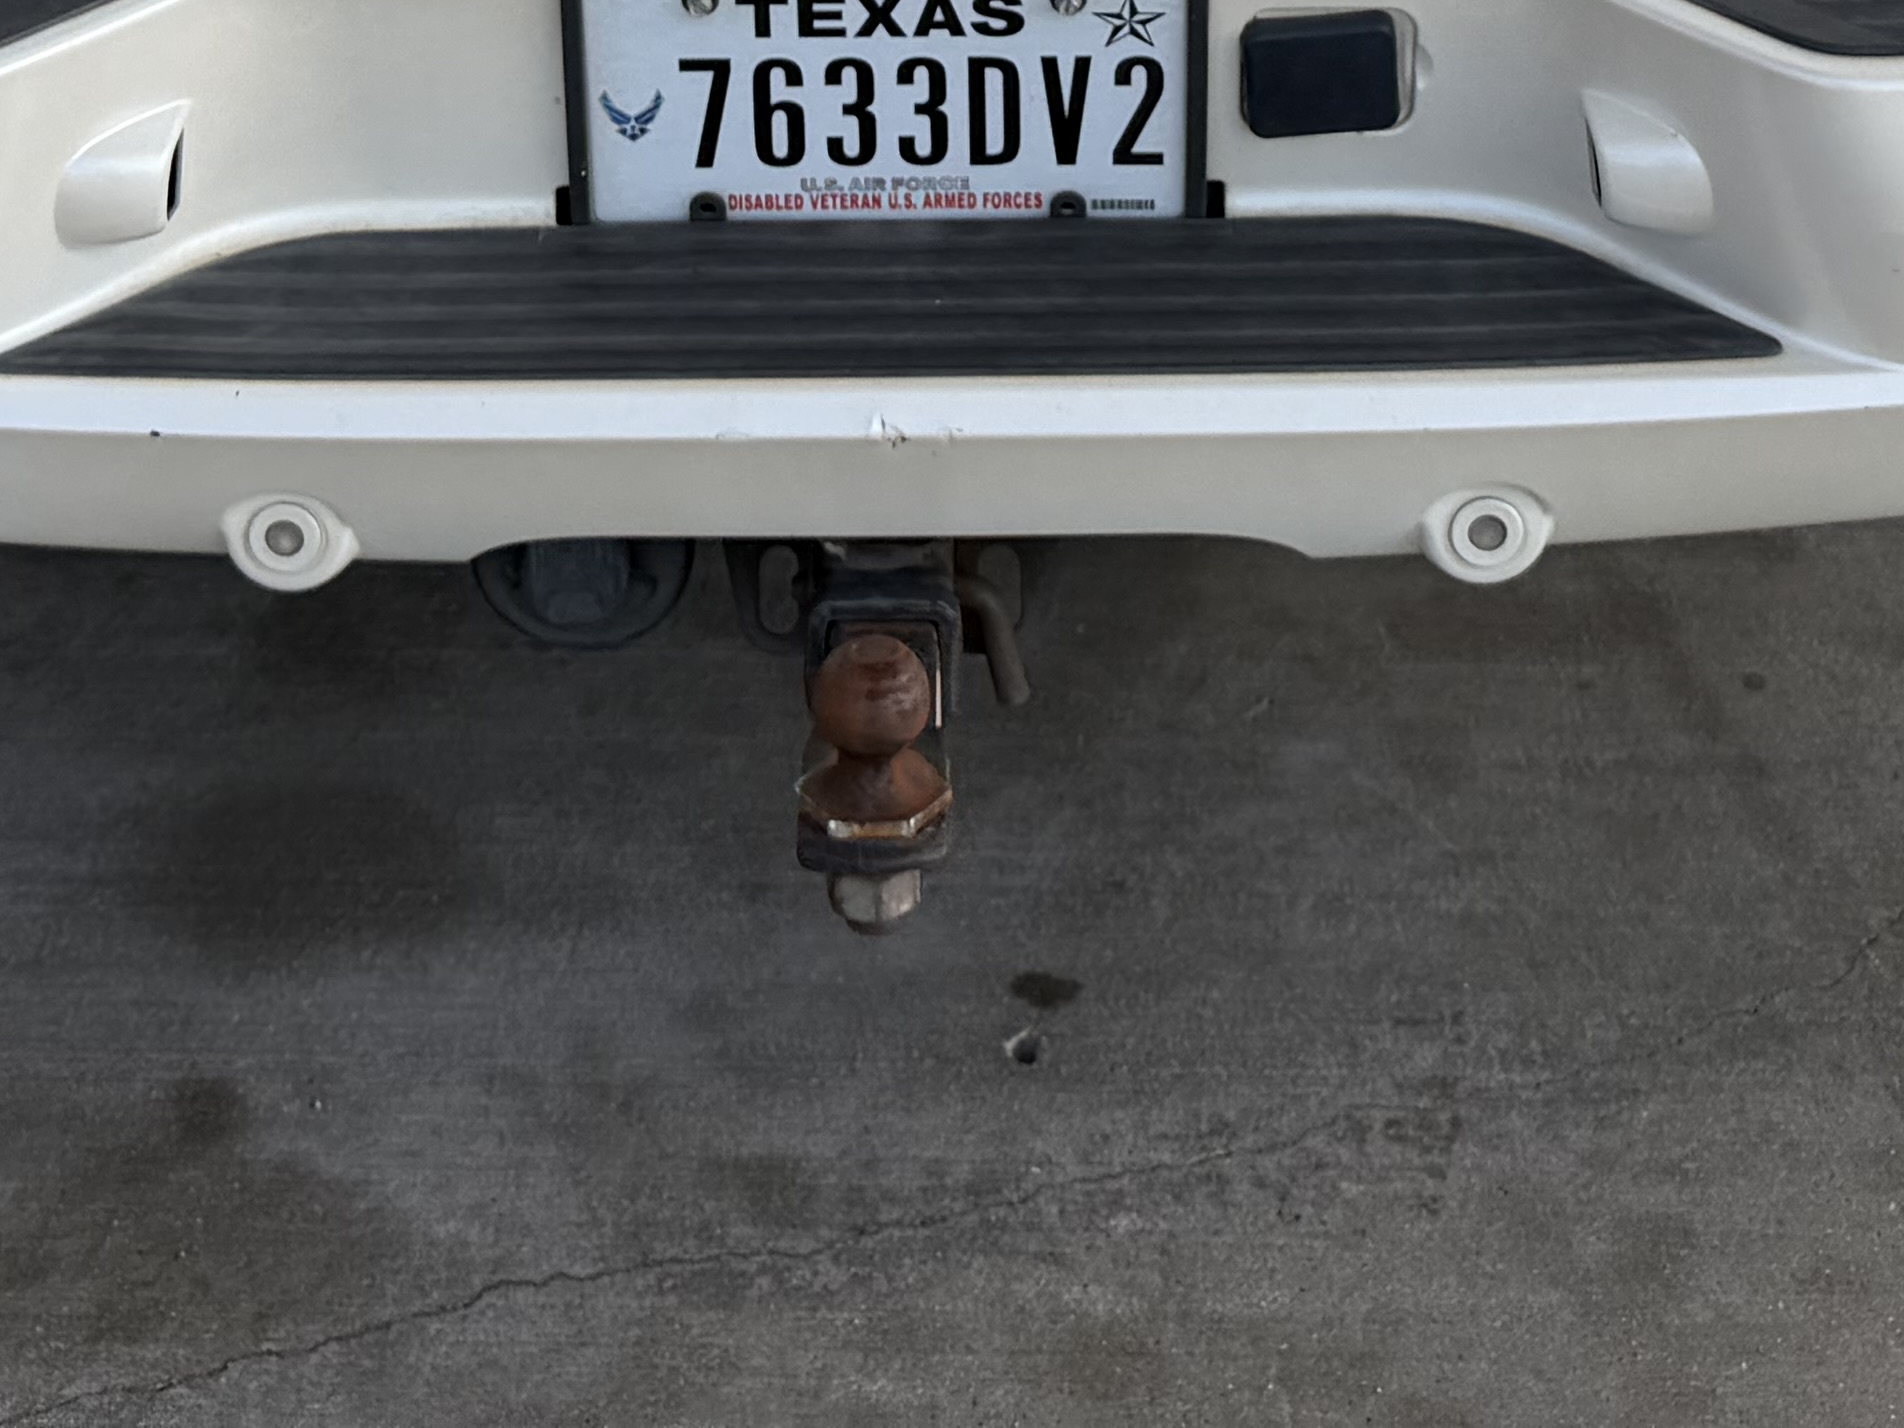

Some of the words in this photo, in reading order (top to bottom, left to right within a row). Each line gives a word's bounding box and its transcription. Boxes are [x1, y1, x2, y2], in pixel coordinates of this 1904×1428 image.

[678, 55, 1165, 169] 7633DV2
[800, 176, 844, 193] U.S.
[848, 176, 887, 192] AIR
[891, 175, 970, 192] FORCE
[728, 193, 804, 211] DISABLED
[810, 192, 882, 210] VETERAN
[888, 192, 918, 210] U.S.
[923, 191, 977, 210] ARMED
[982, 191, 1044, 210] FORCES
